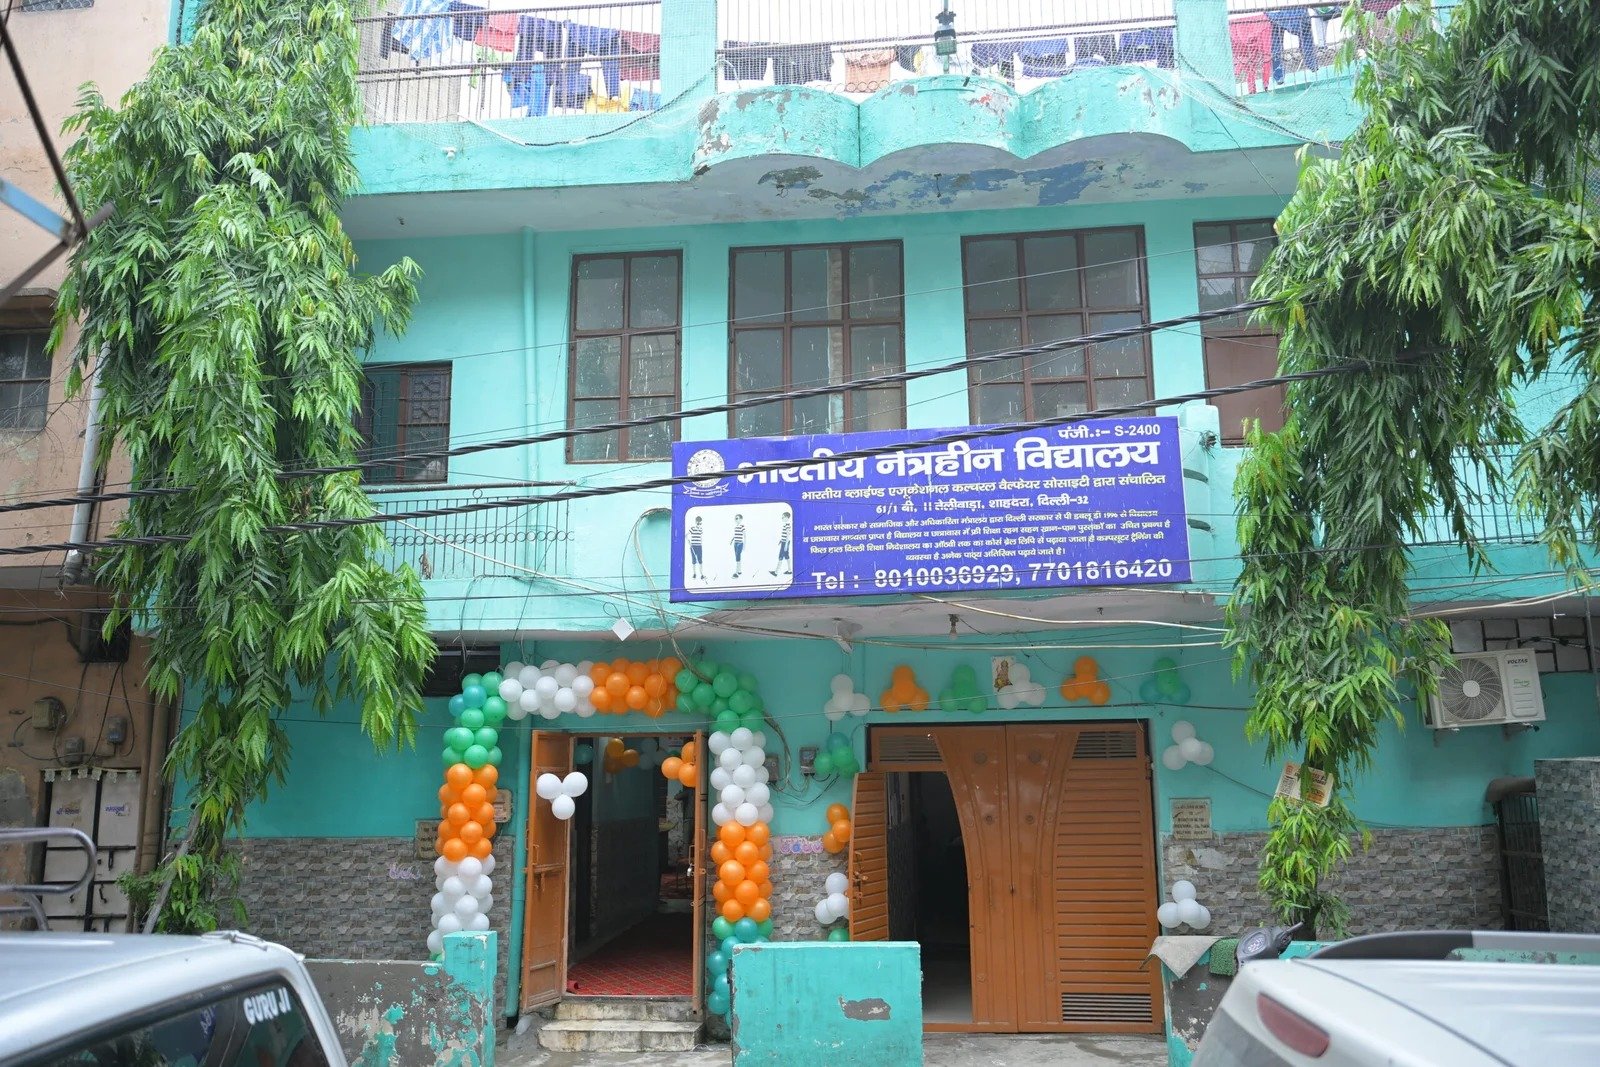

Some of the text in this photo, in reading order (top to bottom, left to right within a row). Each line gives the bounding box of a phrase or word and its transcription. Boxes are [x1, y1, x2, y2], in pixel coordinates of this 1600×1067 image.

[1114, 424, 1160, 437] S-2400
[737, 447, 867, 484] भारतीय
[1013, 437, 1160, 471] विद्यालय
[802, 488, 842, 500] भारतीय
[1043, 475, 1090, 489] सोसाइटी
[1093, 478, 1115, 488] द्वारा
[1118, 473, 1165, 486] संचालित
[876, 503, 897, 514] 61/1
[989, 499, 1033, 509] शाहदरा,
[1037, 494, 1088, 506] दिल्ली-32
[869, 520, 902, 529] सामाजिक
[905, 519, 919, 527] और
[921, 517, 959, 526] अधिकारिता
[1005, 514, 1026, 522] दिल्ली
[1055, 513, 1061, 521] से
[1064, 512, 1071, 520] पी
[1120, 510, 1127, 518] से
[1129, 509, 1157, 517] विद्यालय
[887, 532, 892, 540] है
[894, 531, 922, 539] विद्यालय
[971, 527, 981, 536] फ्री
[983, 527, 1000, 535] शिक्षा
[1078, 523, 1104, 534] पुस्तकों
[1121, 521, 1139, 529] उचित
[1165, 520, 1170, 528] है
[845, 544, 864, 552] दिल्ली
[867, 544, 884, 552] शिक्षा
[986, 538, 1002, 546] कोर्स
[1018, 536, 1035, 545] लिपि
[1088, 534, 1094, 543] है
[934, 553, 939, 561] है
[941, 552, 961, 560] अनेक
[984, 549, 1015, 558] अतिरिक्त
[811, 571, 844, 590] Tel
[874, 563, 1020, 588] 8010036929,
[1028, 558, 1172, 581] 7701816420
[243, 991, 279, 1025] GURU
[278, 987, 291, 1014] JI
